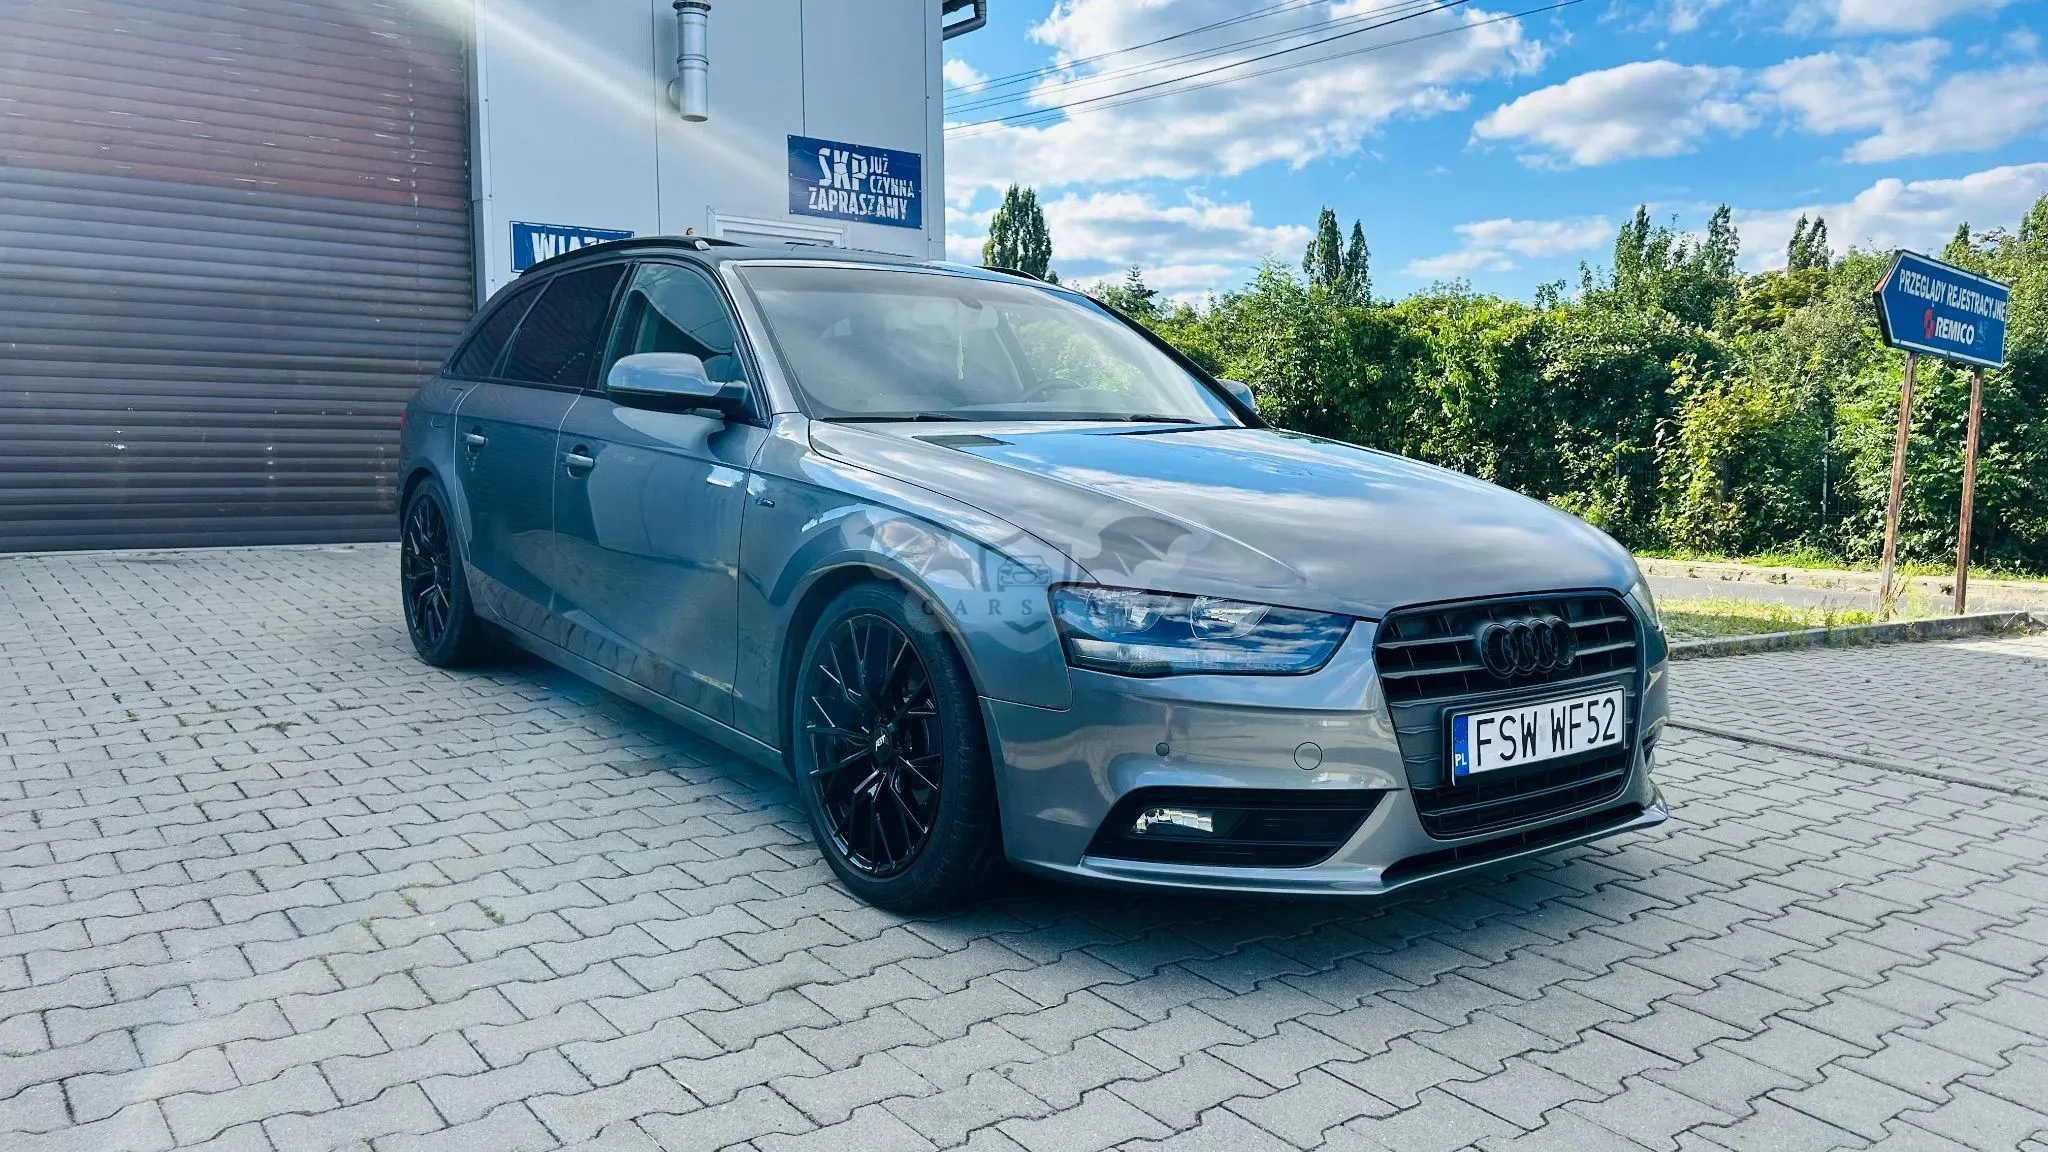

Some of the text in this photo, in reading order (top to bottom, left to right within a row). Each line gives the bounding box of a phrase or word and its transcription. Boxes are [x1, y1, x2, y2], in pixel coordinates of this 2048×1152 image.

[818, 147, 868, 191] SKP
[869, 153, 889, 176] JUŻ
[869, 175, 915, 198] CZYNNA
[808, 186, 908, 220] ZAPRASZAMY
[1946, 283, 2006, 322] REJESTRACYJNE
[1935, 316, 1974, 345] REMICO
[1476, 697, 1616, 767] FSW WF52
[1455, 752, 1468, 767] PL
